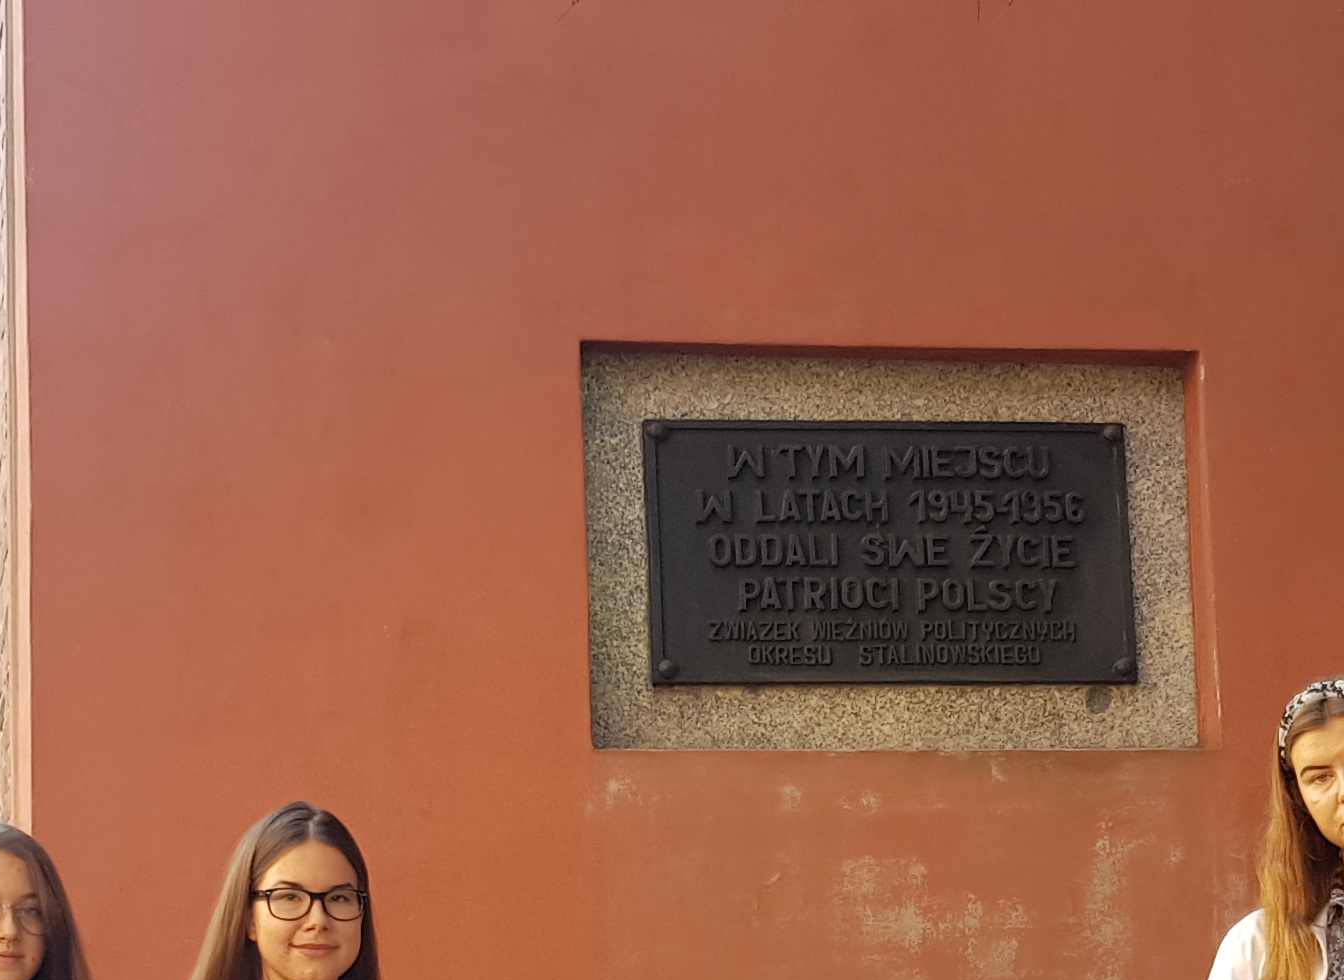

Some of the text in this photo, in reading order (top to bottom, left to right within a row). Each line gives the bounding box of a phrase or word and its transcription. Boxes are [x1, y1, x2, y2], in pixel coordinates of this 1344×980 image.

[728, 444, 1051, 481] W TYM MIEJSCU
[696, 490, 1085, 525] W LATACH 1945-1956
[709, 533, 840, 568] ODDALI
[738, 577, 1056, 614] PATRIOCI POLSCY
[921, 619, 1077, 643] POLITYCZNYCH
[748, 643, 1042, 666] OKRESU STALINOWSKIEGO
